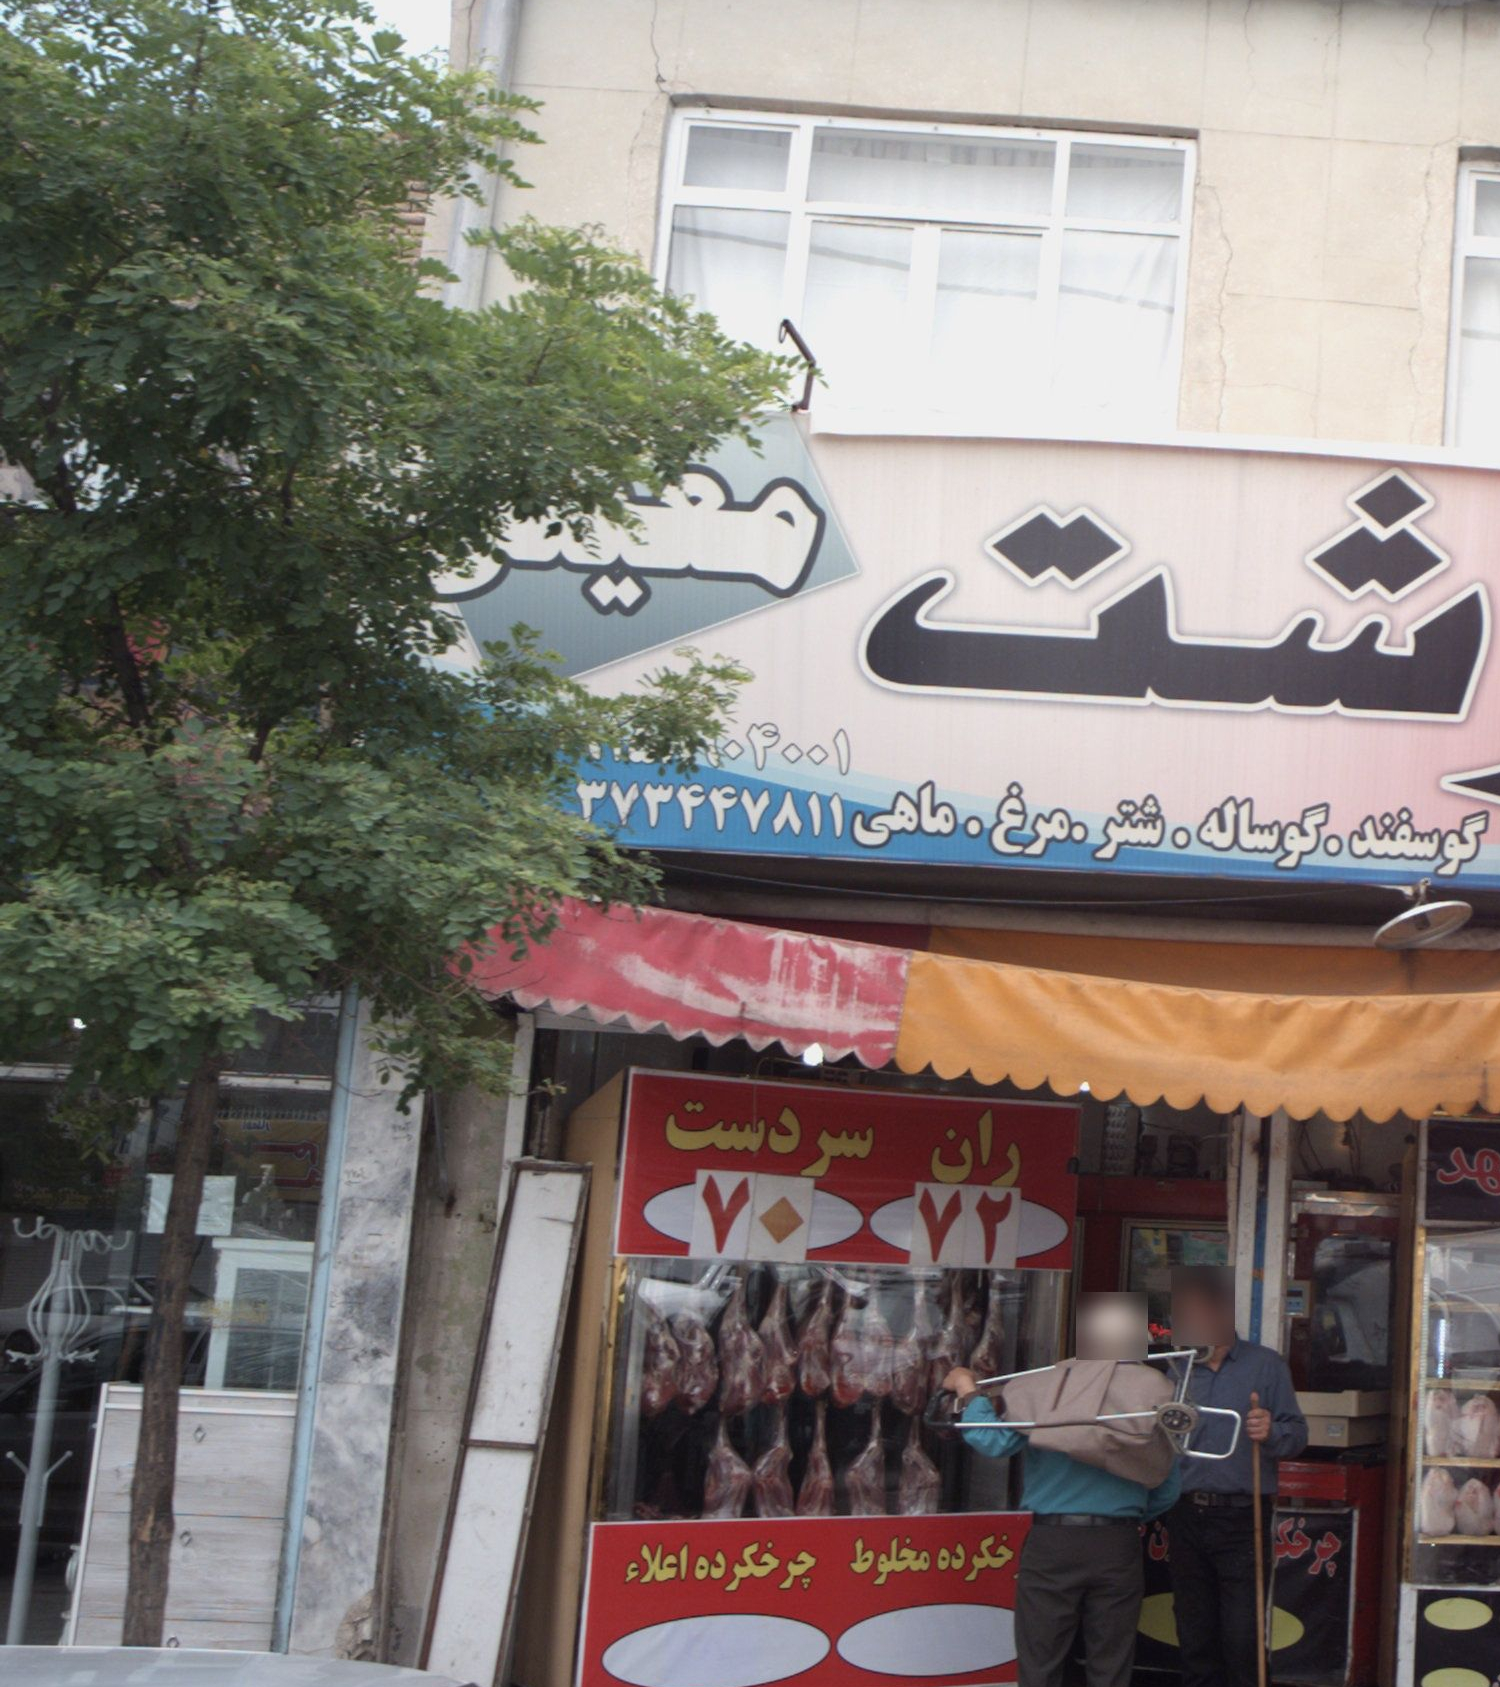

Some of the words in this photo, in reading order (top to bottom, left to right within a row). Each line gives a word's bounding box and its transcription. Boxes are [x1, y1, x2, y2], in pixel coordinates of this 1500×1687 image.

[852, 780, 957, 849] ماهی
[989, 781, 1073, 858] مرغ
[1092, 794, 1166, 861] شتر
[1198, 796, 1330, 870] گوساله
[1349, 807, 1490, 876] گوسفند
[931, 1108, 1021, 1188] ران
[702, 1174, 804, 1254] ۷۰
[918, 1187, 1013, 1265] ۷۲
[850, 1536, 932, 1587] مخلوط
